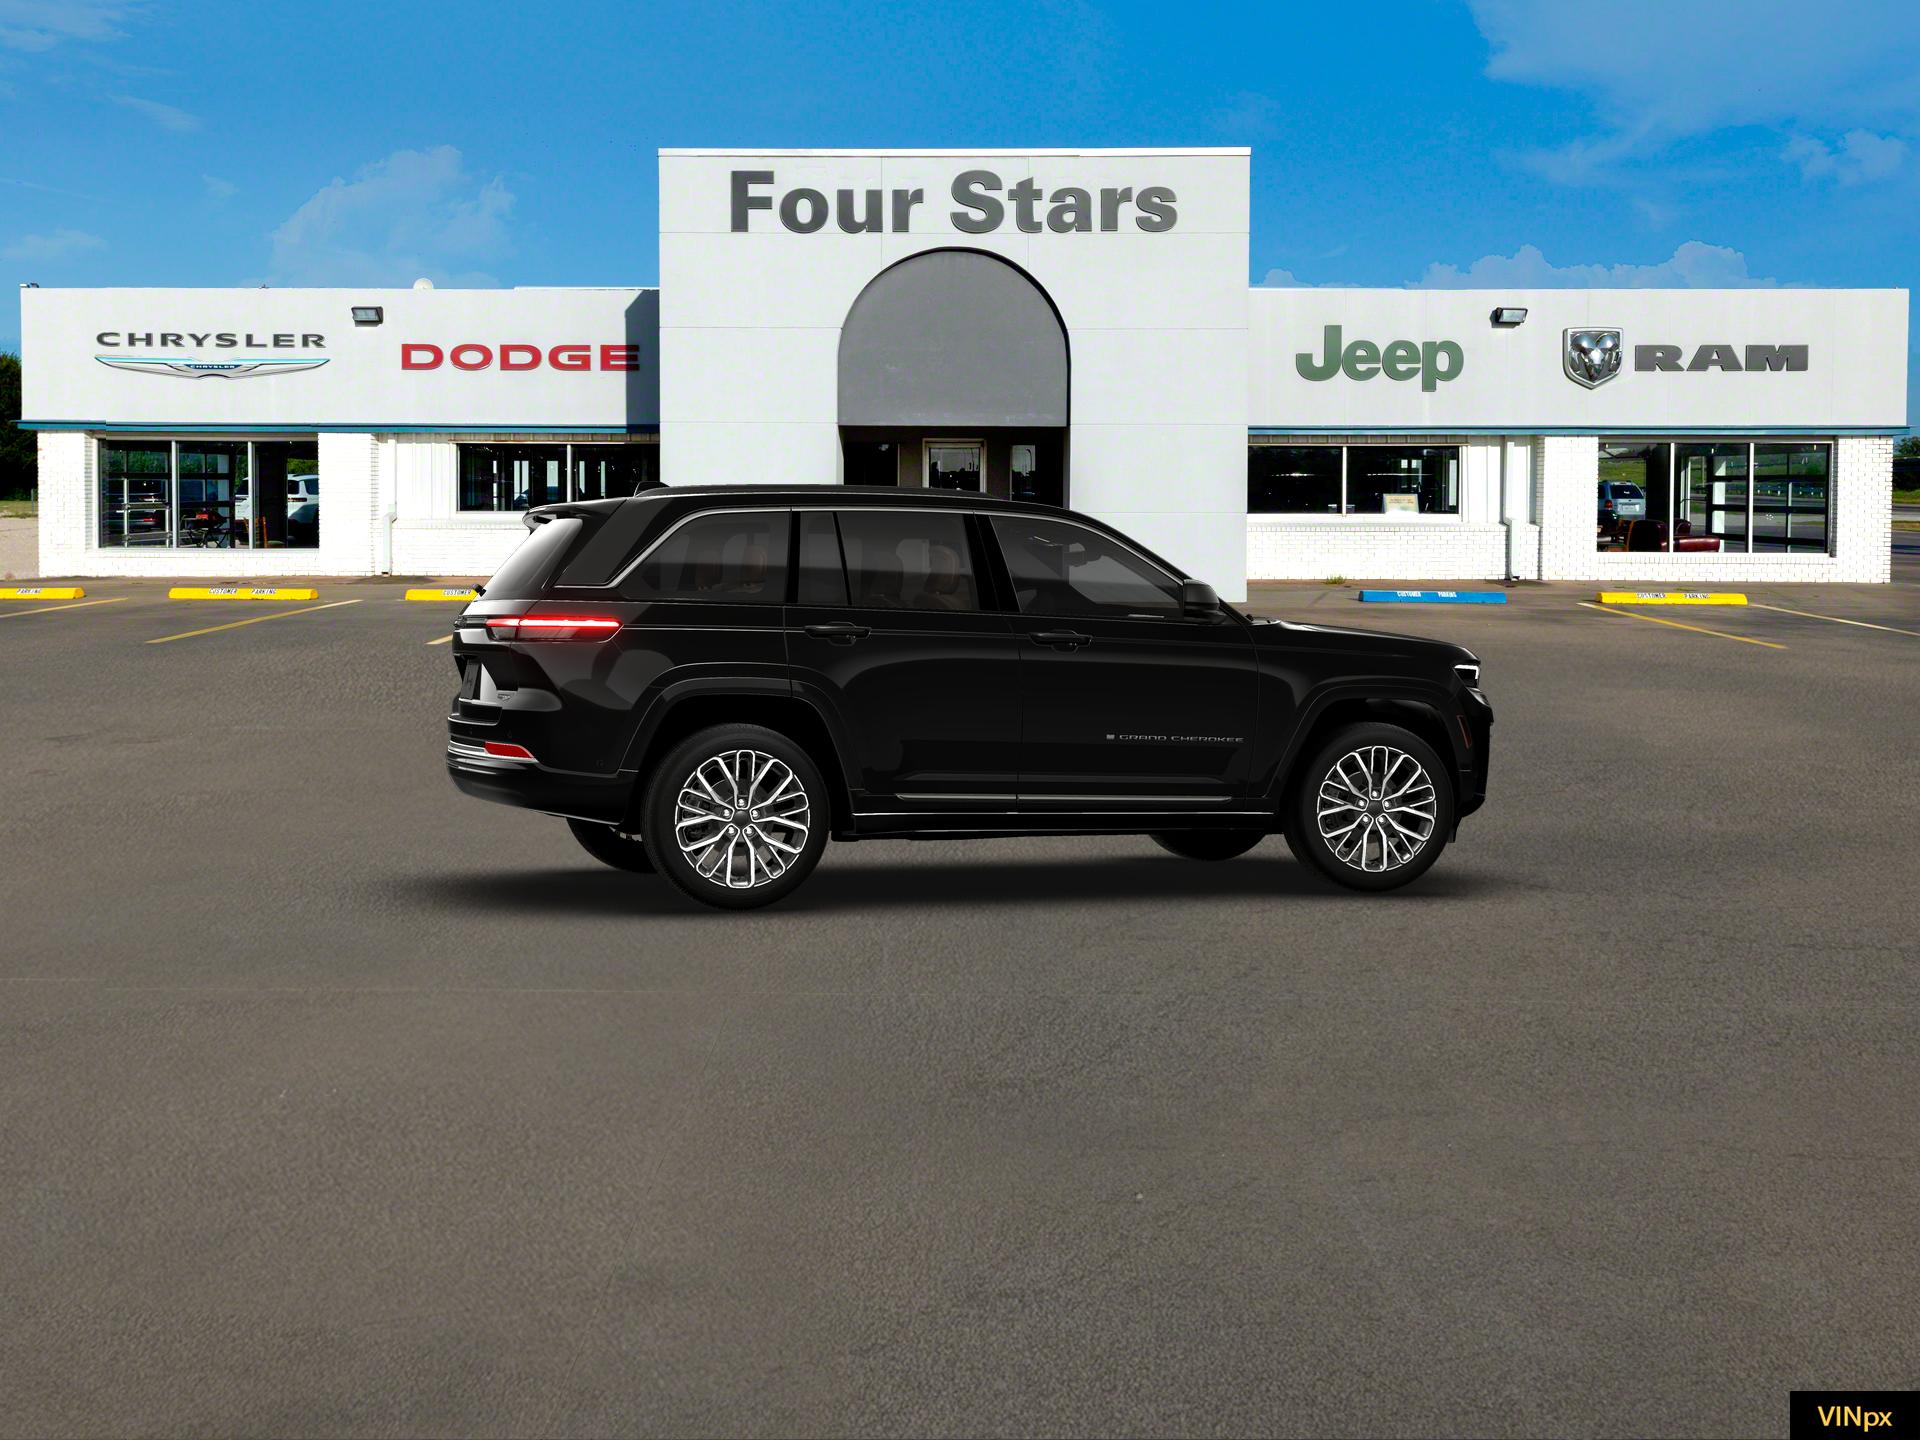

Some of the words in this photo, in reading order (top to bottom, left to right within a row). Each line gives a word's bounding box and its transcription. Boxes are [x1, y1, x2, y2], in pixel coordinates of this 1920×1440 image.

[730, 170, 924, 233] Four
[950, 170, 1178, 233] Stars
[96, 332, 327, 348] CHRYSLER
[401, 343, 640, 371] DODGE
[1295, 325, 1464, 392] Jeep
[1635, 344, 1809, 371] RAM
[1171, 735, 1244, 743] CHEROKEE
